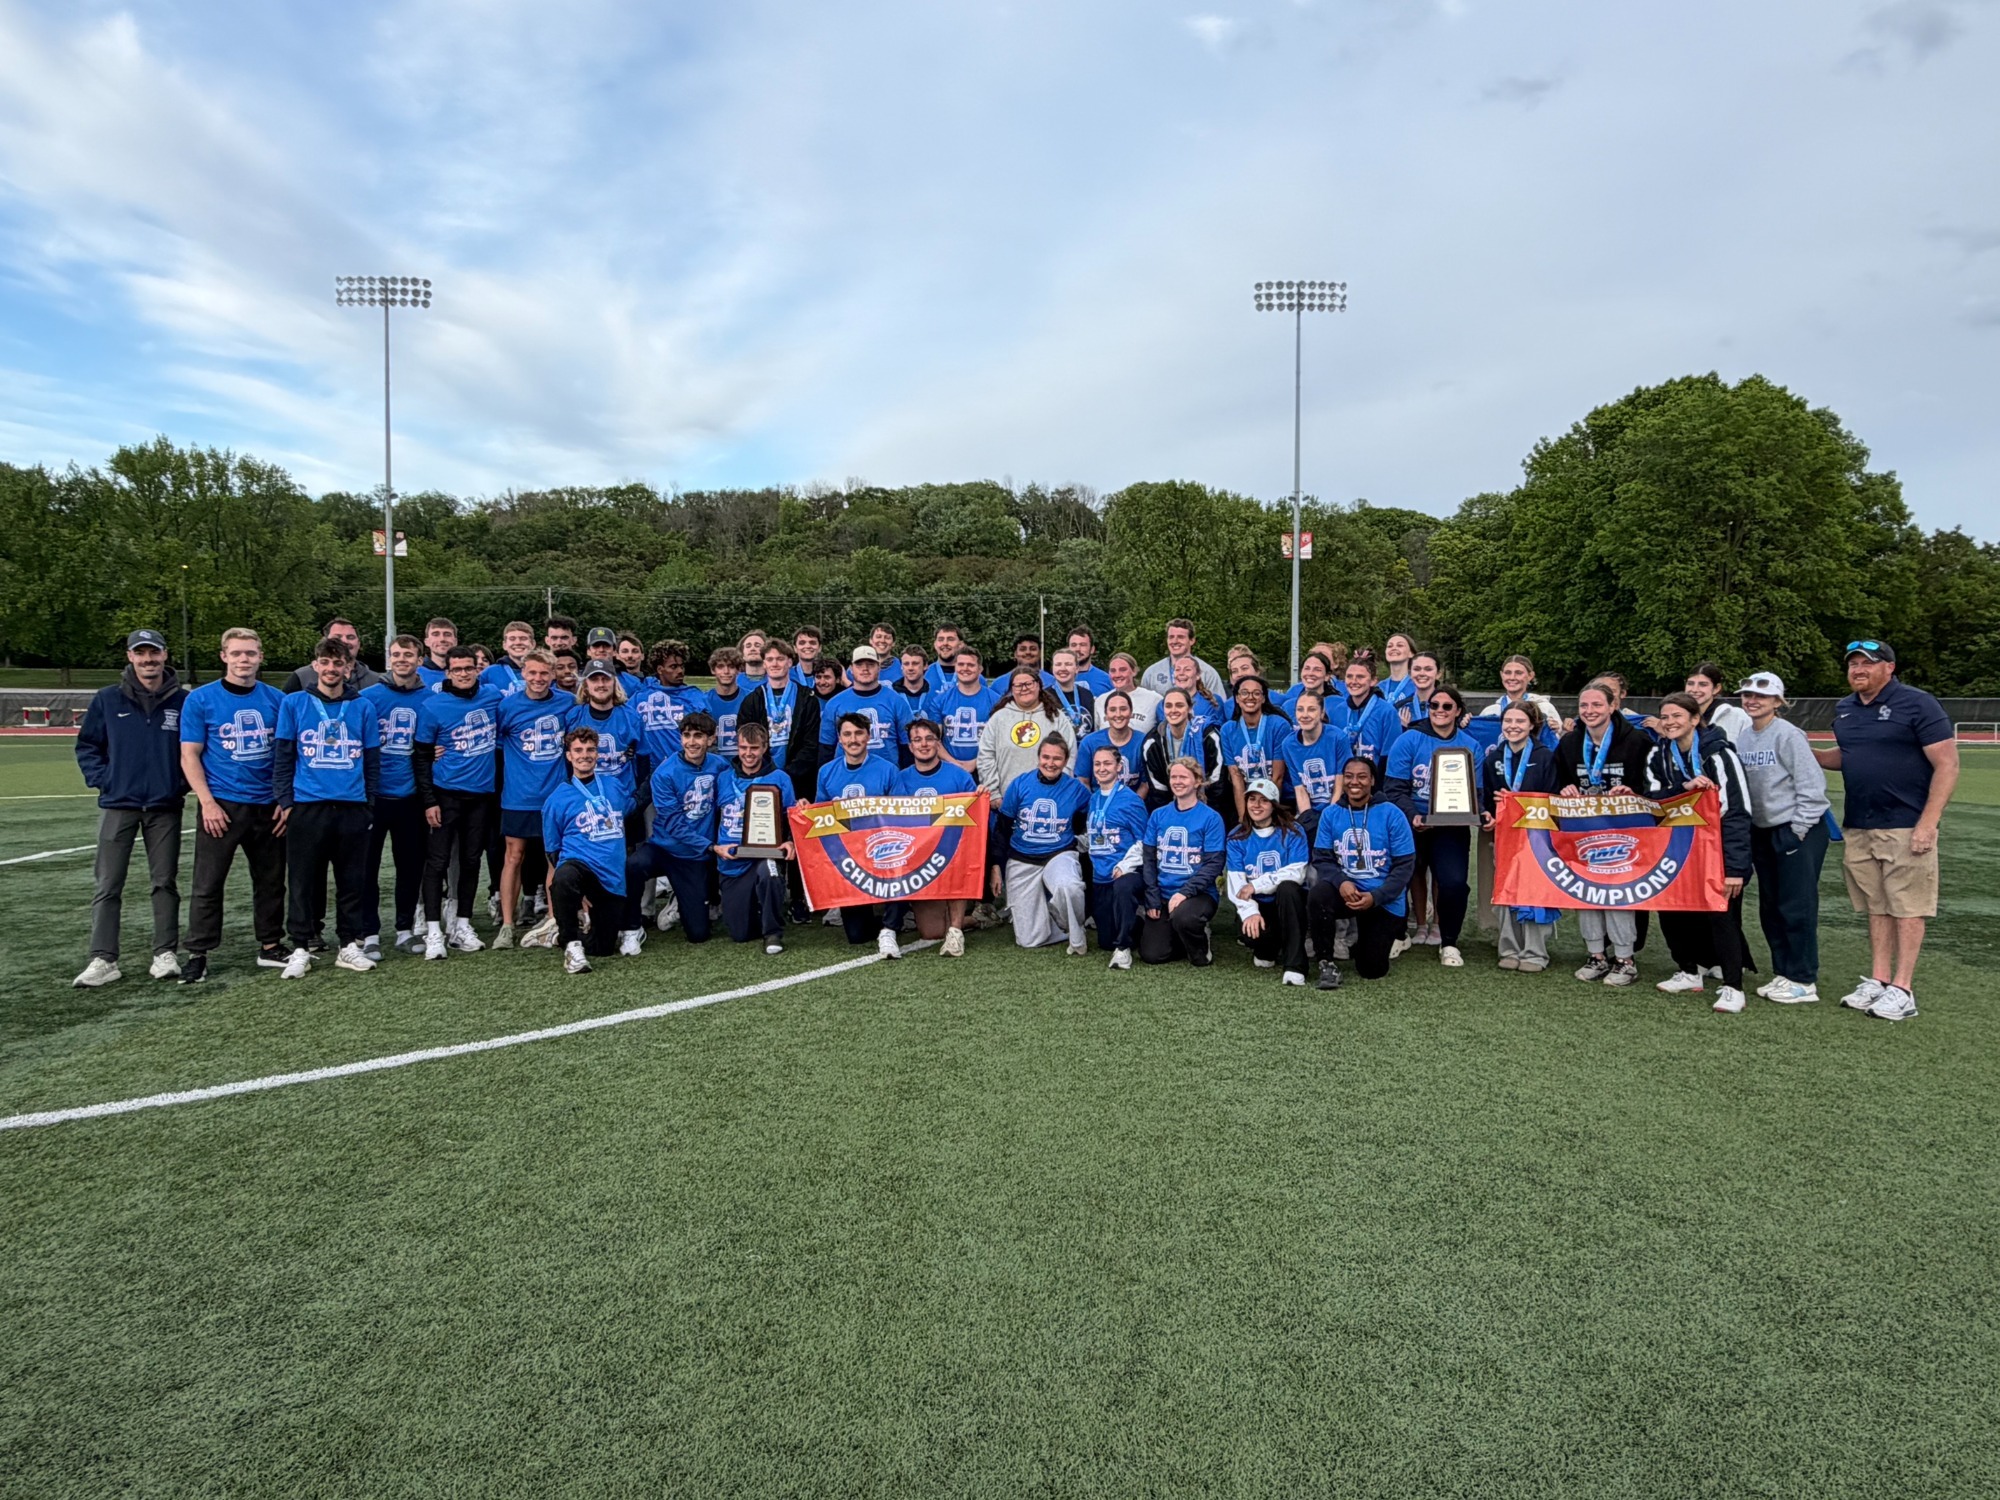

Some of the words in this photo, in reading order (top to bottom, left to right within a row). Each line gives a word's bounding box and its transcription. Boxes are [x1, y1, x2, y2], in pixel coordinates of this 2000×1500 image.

[221, 740, 236, 750] 20
[301, 729, 363, 749] Chapions
[454, 741, 468, 750] 20
[302, 746, 315, 756] 20
[349, 748, 362, 758] 26
[523, 743, 535, 751] 20
[1737, 750, 1776, 765] UMBIA
[841, 798, 876, 809] MEN'S
[879, 797, 936, 806] OUTDOOR
[1550, 796, 1598, 808] WOMEN'S
[1601, 795, 1661, 809] OUTDOOR
[848, 806, 883, 817] TRACK
[887, 806, 896, 815] &
[900, 806, 932, 815] FIELD
[944, 805, 965, 818] 26
[1525, 806, 1548, 820] 20
[1558, 806, 1597, 818] TRACK
[1601, 806, 1609, 815] &
[1616, 804, 1652, 815] FIELD
[1666, 803, 1693, 818] 26
[723, 818, 732, 827] 20
[814, 814, 834, 828] 20
[1109, 835, 1121, 844] 26
[867, 840, 911, 860] AMC
[1580, 844, 1635, 864] AMC
[1189, 855, 1201, 864] 26
[842, 852, 946, 898] CHAMPIONS
[1547, 857, 1677, 905] CHAMPIONS
